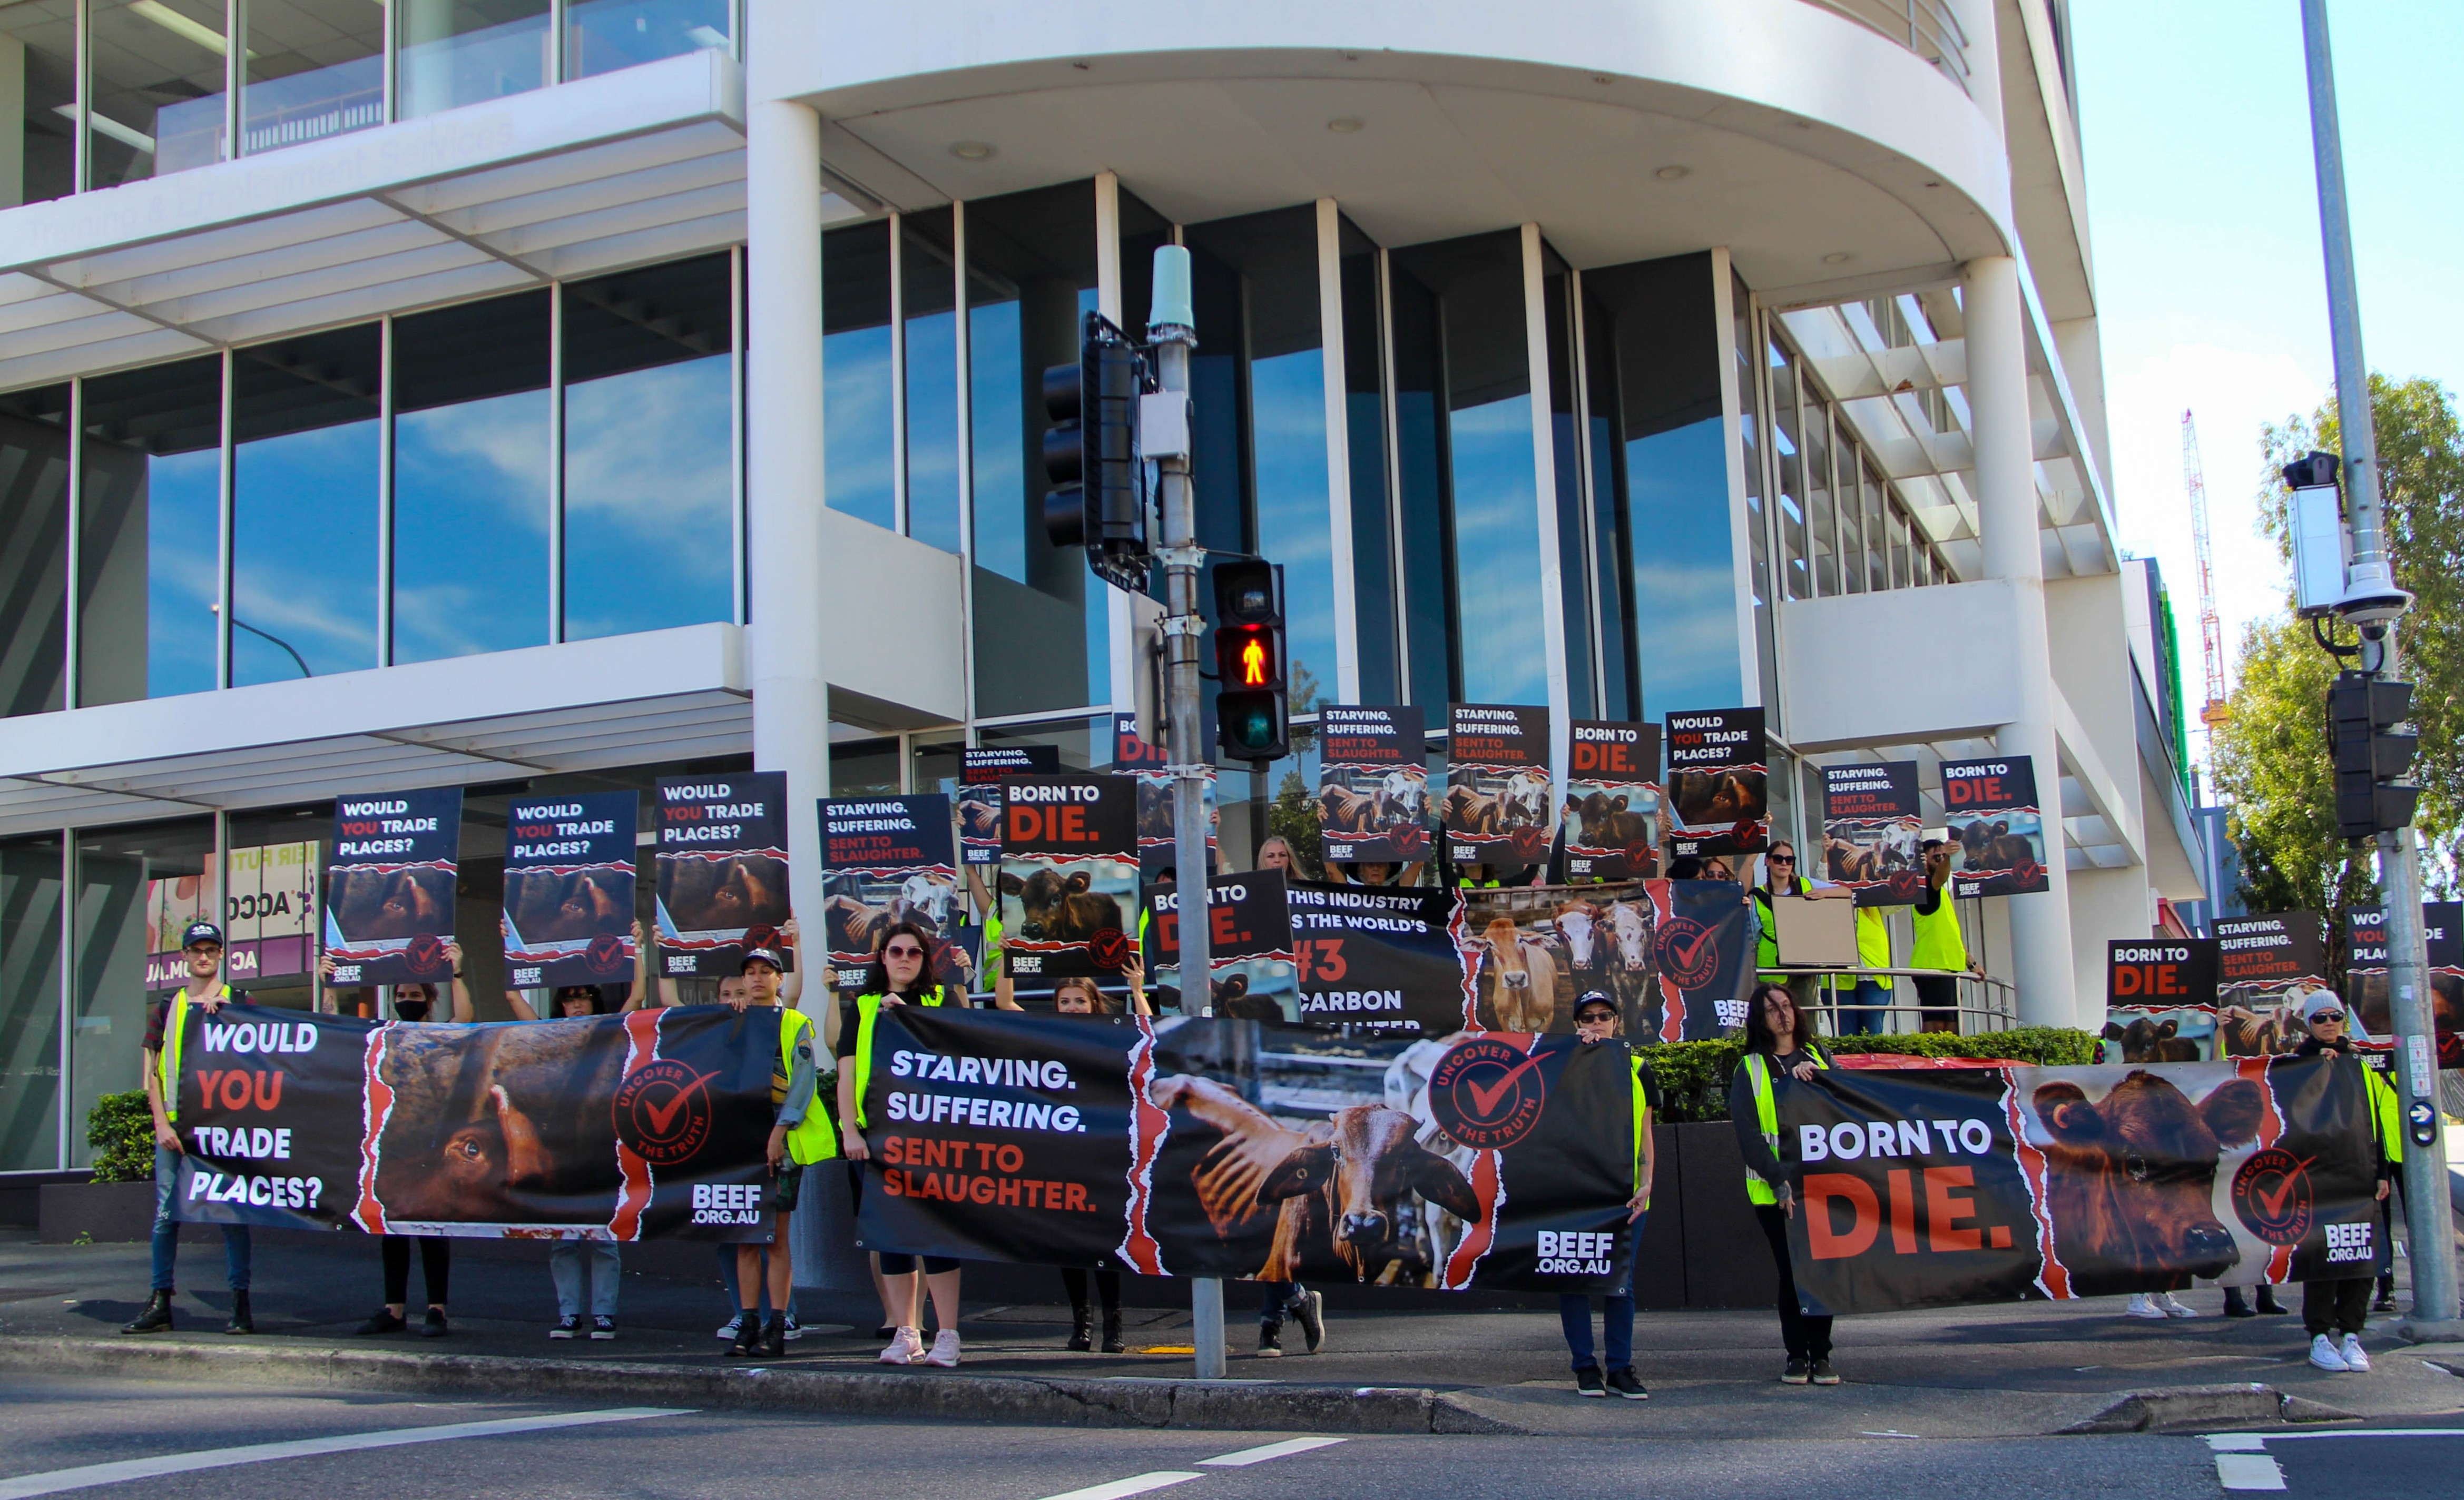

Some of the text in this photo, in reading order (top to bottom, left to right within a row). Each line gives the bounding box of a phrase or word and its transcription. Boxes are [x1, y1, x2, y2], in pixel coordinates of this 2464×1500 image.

[1326, 710, 1390, 721] STARVING.
[1455, 708, 1517, 721] STARVING.
[1672, 716, 1723, 729] WOULD
[1120, 720, 1136, 732] BO
[1327, 724, 1396, 734] SUFFERING.
[1455, 723, 1523, 735] SUFFERING.
[1328, 738, 1377, 747] SENT TO
[1456, 737, 1504, 747] SENT TO
[1575, 727, 1637, 742] BORN TO
[1673, 731, 1748, 745] YOU TRADE
[1328, 749, 1402, 758] SLAUGHTER.
[1456, 748, 1527, 760] SLAUGHTER.
[1574, 743, 1636, 772] DIE.
[1674, 747, 1732, 761] PLACES?
[966, 758, 1032, 766] SUFFERING.
[1828, 767, 1887, 780] STARVING.
[1945, 764, 2008, 778] BORN TO
[663, 784, 731, 800] WOULD
[1009, 785, 1100, 802] BORN TO
[1829, 781, 1893, 792] SUFFERING.
[1948, 777, 2013, 804] DIE.
[1830, 794, 1876, 805] SENT TO
[343, 800, 408, 816] WOULD
[516, 804, 582, 820] WOULD
[664, 803, 764, 820] YOU TRADE
[827, 802, 907, 816] STARVING.
[1831, 803, 1899, 815] SLAUGHTER.
[341, 817, 438, 835] YOU TRADE
[515, 820, 614, 838] YOU TRADE
[828, 818, 916, 833] SUFFERING.
[1009, 805, 1100, 841] DIE.
[664, 824, 741, 842] PLACES?
[339, 838, 414, 855] PLACES?
[514, 841, 591, 858] PLACES?
[829, 836, 891, 850] SENT TO
[1330, 845, 1352, 853] BEEF
[1454, 846, 1476, 854] BEEF
[830, 847, 924, 862] SLAUGHTER.
[1570, 860, 1592, 869] BEEF
[1216, 884, 1246, 902] TO
[1958, 883, 1980, 891] BEEF
[1286, 890, 1423, 911] THIS INDUSTRY
[1157, 906, 1252, 952] DE.
[1307, 914, 1342, 928] THE
[1343, 915, 1427, 933] WORLD'S
[2217, 920, 2284, 935] STARVING.
[1657, 922, 1695, 950] UNCOVER
[2220, 934, 2292, 950] SUFFERING.
[2353, 931, 2386, 943] YOU
[668, 955, 695, 966] BEEF
[1013, 956, 1042, 967] BEEF
[1293, 939, 1347, 982] #3
[2115, 948, 2188, 962] BORN TO
[2223, 952, 2274, 965] SENT TO
[334, 965, 361, 975] BEEF
[513, 967, 541, 979] BEEF
[838, 969, 866, 980] BEEF
[1672, 955, 1713, 985] THE TRUTH
[2224, 961, 2301, 977] SLAUGHTER.
[2115, 965, 2188, 995] DIE.
[1300, 990, 1401, 1012] CARBON
[1718, 1017, 1745, 1028] .ORG.A
[204, 1022, 318, 1052] WOULD
[891, 1050, 1076, 1089] STARVING.
[1437, 1045, 1511, 1086] UNCOVER
[197, 1070, 284, 1110] YOU
[620, 1067, 684, 1107] UNCOVER
[887, 1092, 1086, 1132] SUFFERING.
[1455, 1097, 1537, 1143] THE TRUTH
[194, 1127, 291, 1159] TRADE
[636, 1116, 704, 1157] THE TRUTH
[1799, 1119, 1991, 1161] BORN TO
[883, 1136, 1024, 1173] SENT TO
[2236, 1155, 2288, 1196] UNCOVER
[188, 1171, 322, 1208] PLACES?
[692, 1185, 761, 1209] BEEF
[883, 1169, 1096, 1212] SLAUGHTER.
[692, 1211, 759, 1224] .ORG.AU
[1803, 1166, 2013, 1260] DIE.
[2260, 1200, 2308, 1241] THE TRUTH
[2324, 1222, 2371, 1248] BEEF
[1538, 1230, 1613, 1258] BEEF
[2326, 1247, 2372, 1262] .ORG.AU
[1535, 1259, 1611, 1274] .ORG.AU
